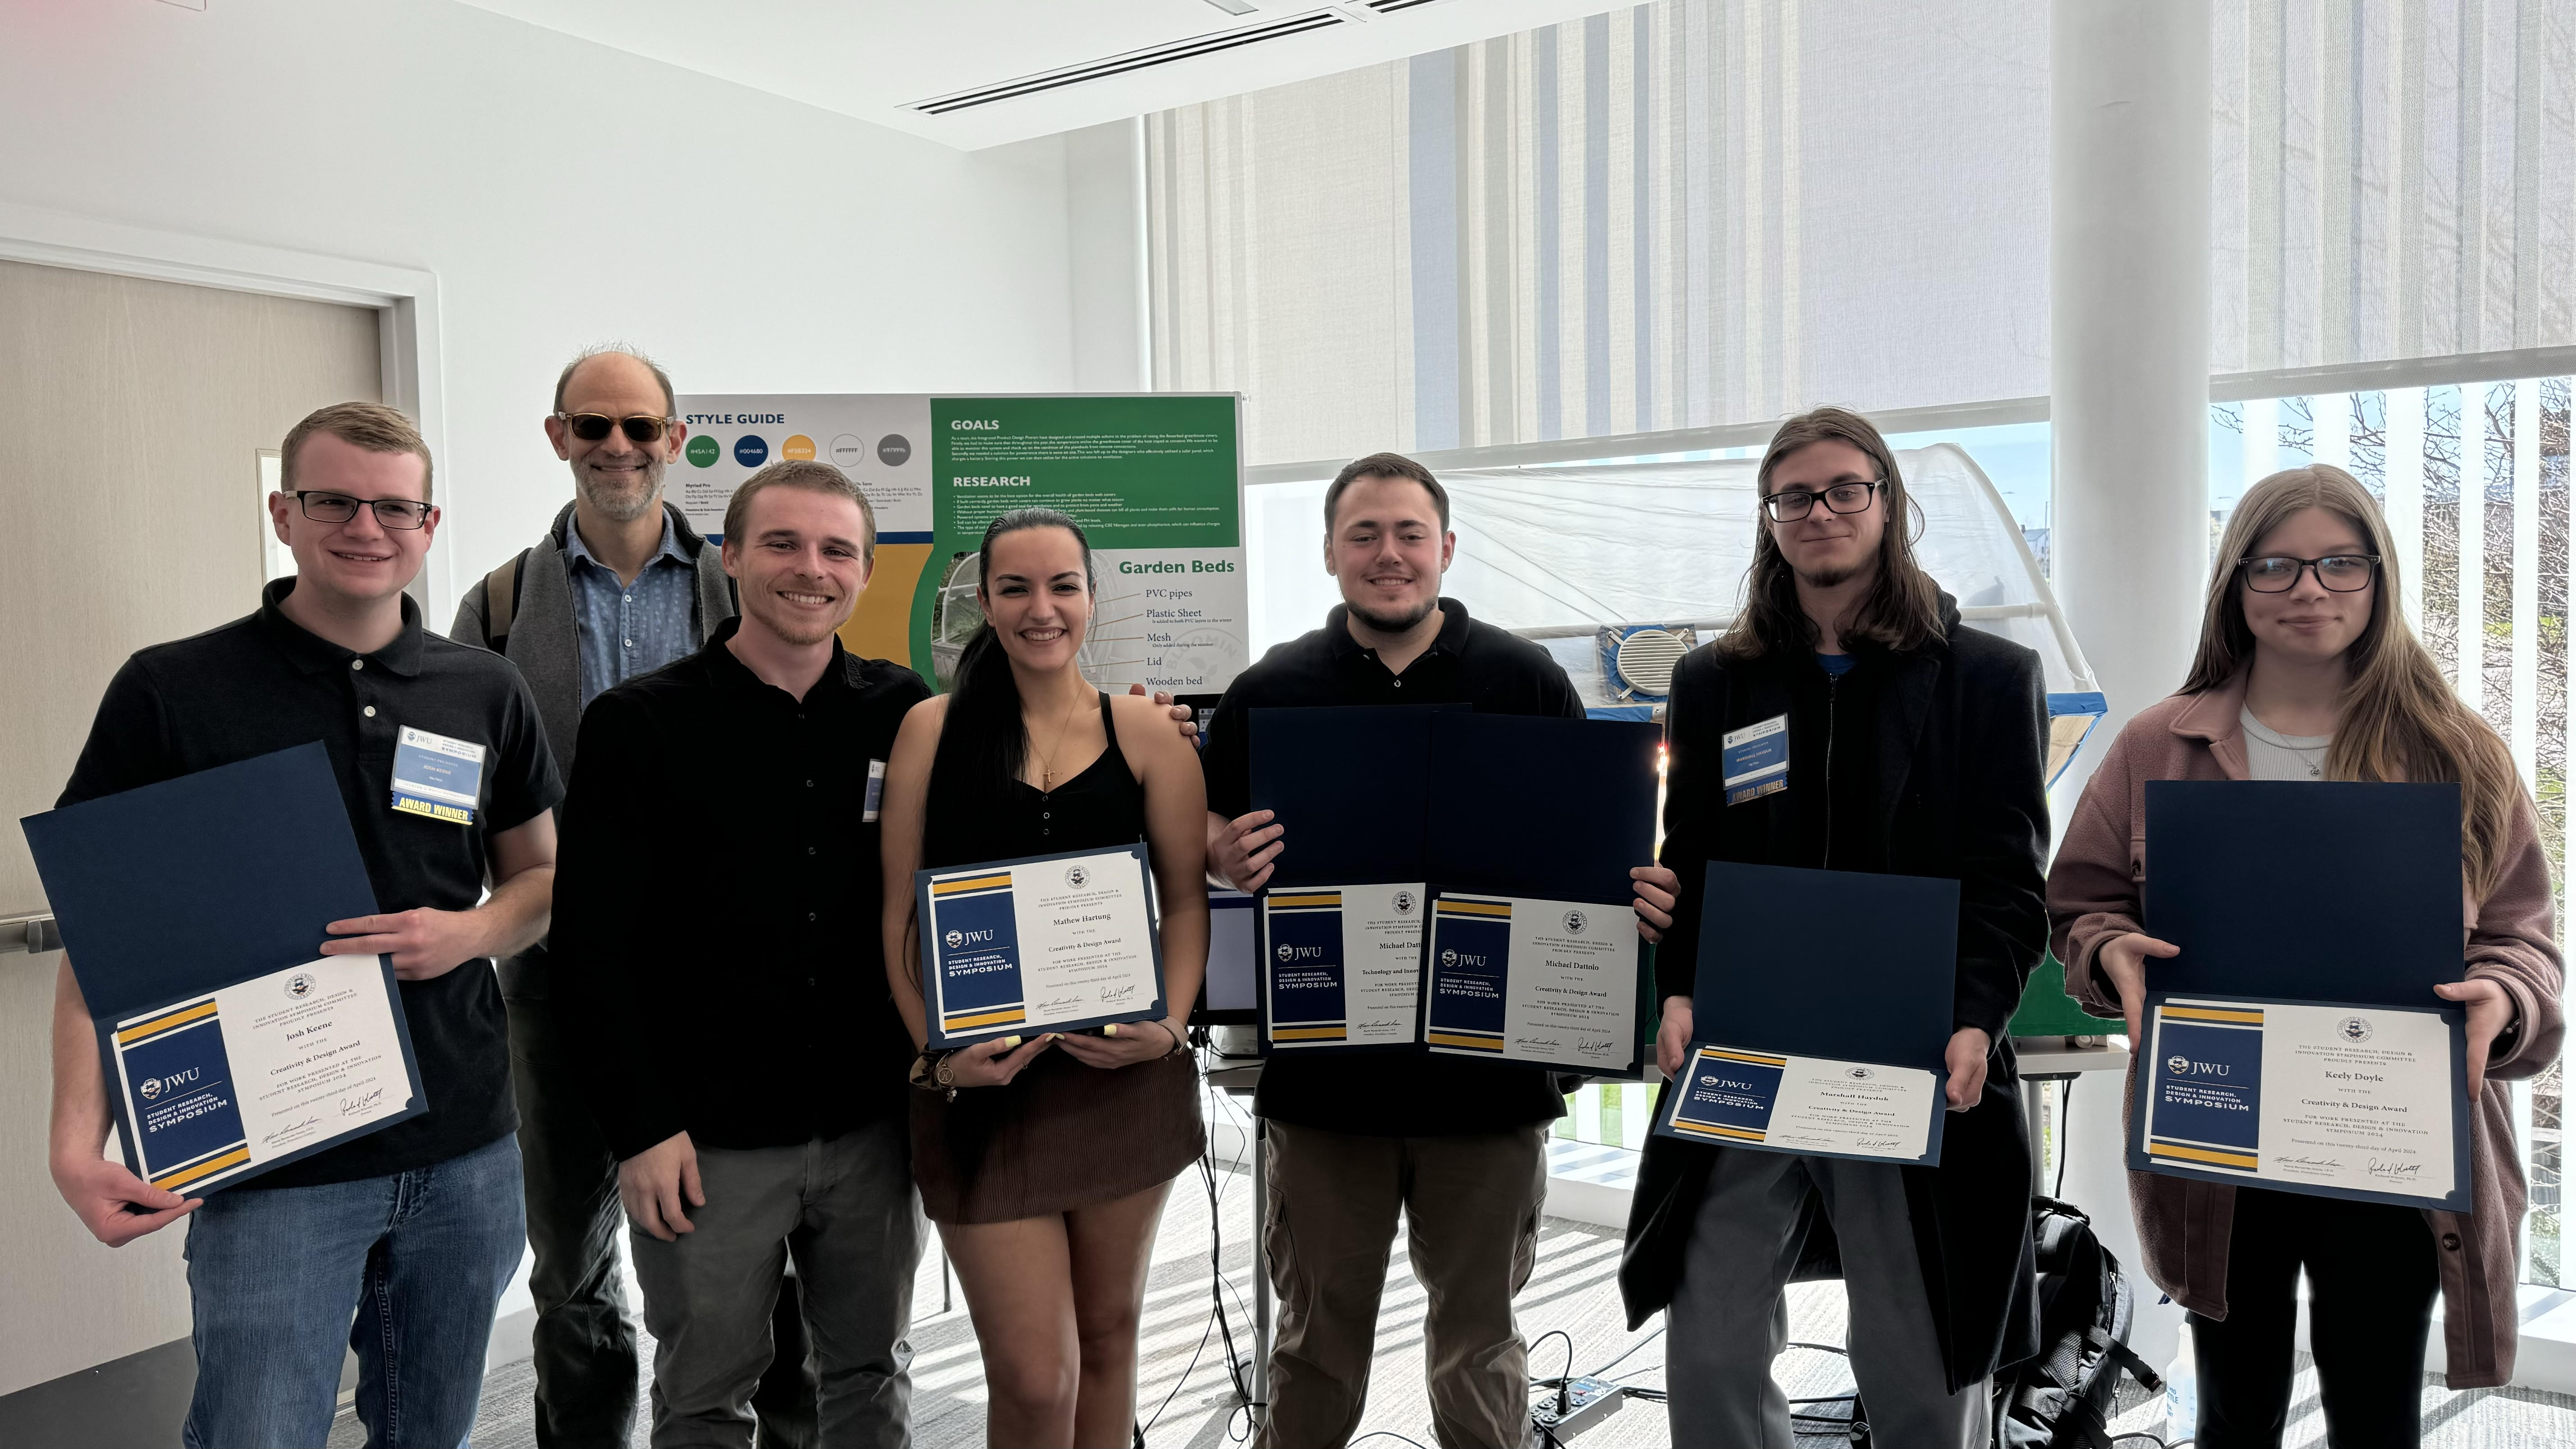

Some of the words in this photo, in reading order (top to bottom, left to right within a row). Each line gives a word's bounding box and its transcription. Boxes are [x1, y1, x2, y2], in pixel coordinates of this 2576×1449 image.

[686, 414, 732, 424] STYLE
[737, 414, 785, 423] GUIDE
[951, 420, 999, 430] GOALS
[953, 476, 1030, 487] RESEARCH
[1119, 561, 1185, 574] Garden
[1192, 560, 1234, 572] Beds
[1169, 590, 1192, 599] pipes
[1178, 609, 1201, 617] Sheet
[1147, 633, 1171, 641] Mesh
[1147, 658, 1161, 666] Lid
[1187, 676, 1202, 685] bed
[416, 735, 432, 744] JWU
[1734, 733, 1745, 742] JWU
[442, 746, 476, 758] SYMPOSIUM
[1732, 787, 1755, 802] AWARD
[1757, 779, 1783, 794] WINNER
[400, 797, 431, 812] AWARD
[434, 804, 468, 820] WINNER
[1053, 917, 1080, 925] Mathew
[1082, 914, 1111, 922] Hartung
[965, 929, 994, 945] JWU
[1049, 943, 1075, 952] Creativity
[1295, 947, 1321, 960] JWU
[1458, 954, 1486, 966] JWU
[1546, 960, 1572, 968] Michael
[949, 964, 1012, 977] SYMPOSIUM
[1440, 989, 1498, 998] SYMPOSIUM
[1535, 986, 1562, 994] Creativity
[286, 1030, 304, 1042] Josh
[307, 1021, 333, 1034] Keene
[271, 1059, 304, 1076] Creativity
[313, 1049, 337, 1061] Design
[338, 1040, 360, 1052] Award
[2191, 1062, 2230, 1075] JWU
[164, 1067, 199, 1093] JWU
[2326, 1072, 2351, 1081] Keely
[2355, 1073, 2383, 1082] Doyle
[1719, 1080, 1752, 1090] JWU
[2199, 1089, 2236, 1097] RESEARCH,
[1694, 1096, 1763, 1109] SYMPOSIUM
[2165, 1096, 2249, 1111] SYMPOSIUM
[2199, 1095, 2240, 1103] INNOVATION
[147, 1105, 176, 1119] STUDENT
[178, 1093, 213, 1108] RESEARCH,
[2302, 1099, 2341, 1108] Creativity
[2351, 1103, 2379, 1111] Design
[149, 1114, 171, 1125] DESIGN
[179, 1097, 218, 1113] INNOVATION
[149, 1099, 227, 1132] SYMPOSIUM
